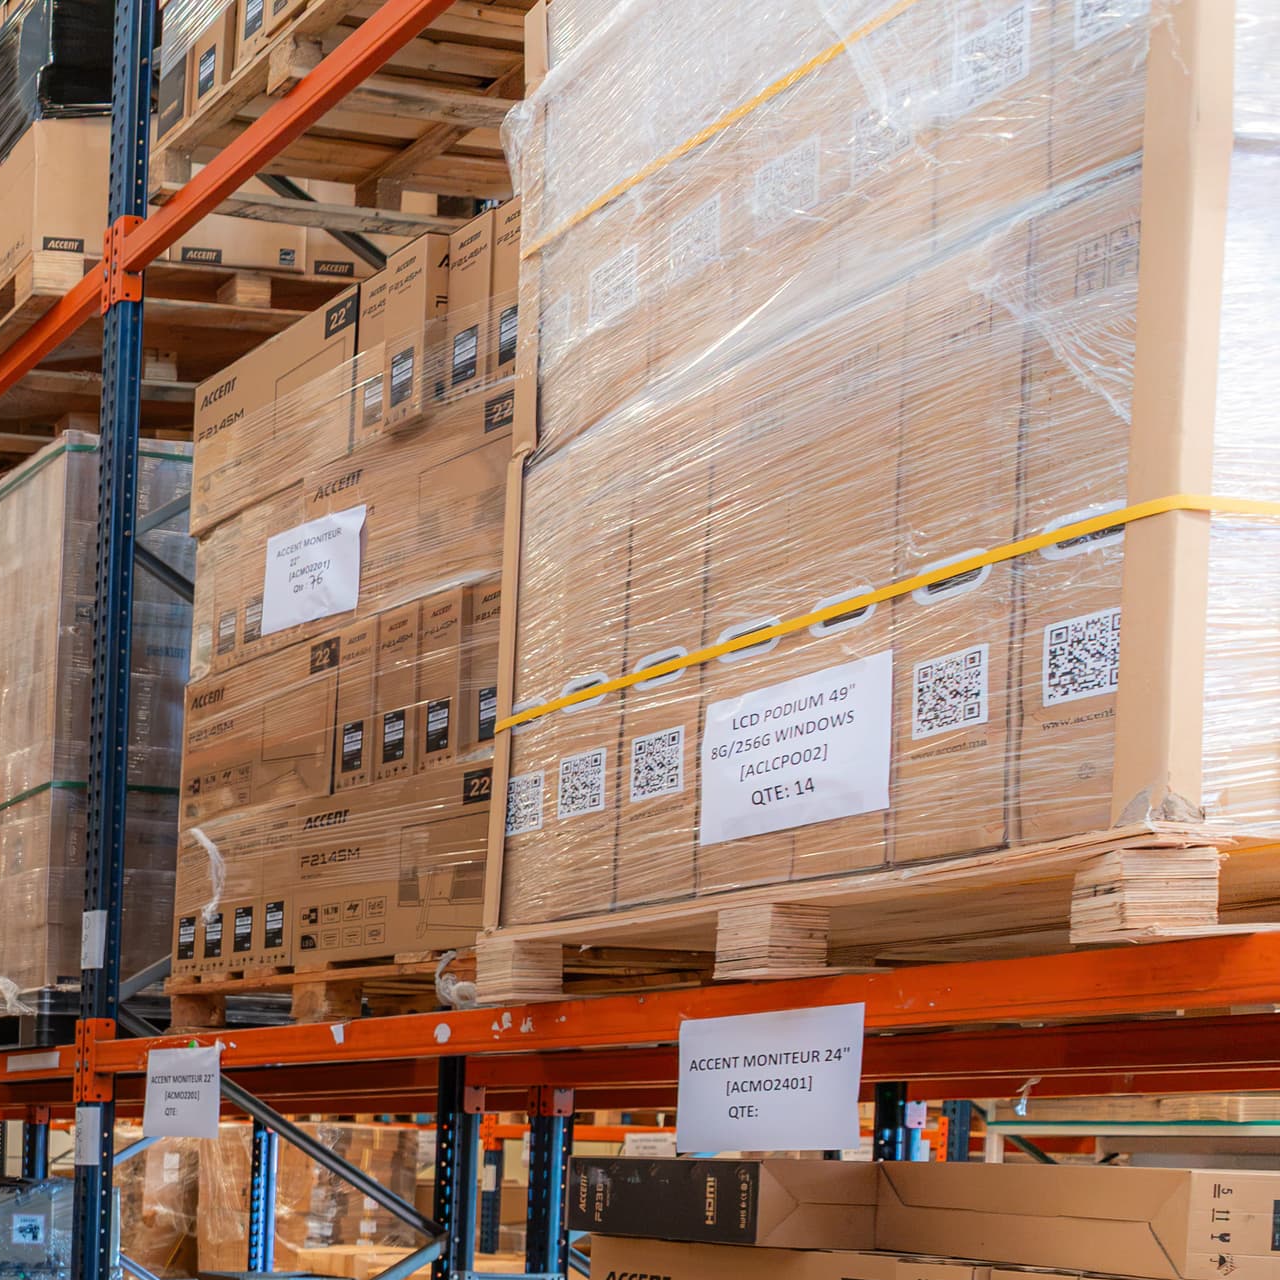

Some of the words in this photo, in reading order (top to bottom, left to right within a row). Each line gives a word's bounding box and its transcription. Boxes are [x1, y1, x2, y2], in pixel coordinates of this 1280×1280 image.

[47, 238, 82, 252] ACCENT
[185, 249, 219, 262] ACCENT
[318, 262, 351, 274] ACCENT
[200, 375, 237, 411] ACCENT
[313, 467, 364, 503] ACCENT
[190, 686, 225, 711] ACCENT
[731, 711, 761, 733] LCD
[763, 696, 824, 725] PODIUM
[828, 682, 857, 704] 49"
[710, 733, 772, 762] 8G/256G
[774, 709, 856, 745] WINDOWS
[750, 784, 792, 808] QTE:
[795, 776, 816, 796] 14
[302, 808, 351, 832] ACCENT
[689, 1056, 740, 1073] ACCENT
[743, 1050, 821, 1068] MONITEUR
[824, 1046, 852, 1063] 24"
[726, 1075, 813, 1097] [ACMO2401]
[728, 1105, 759, 1120] QTE:
